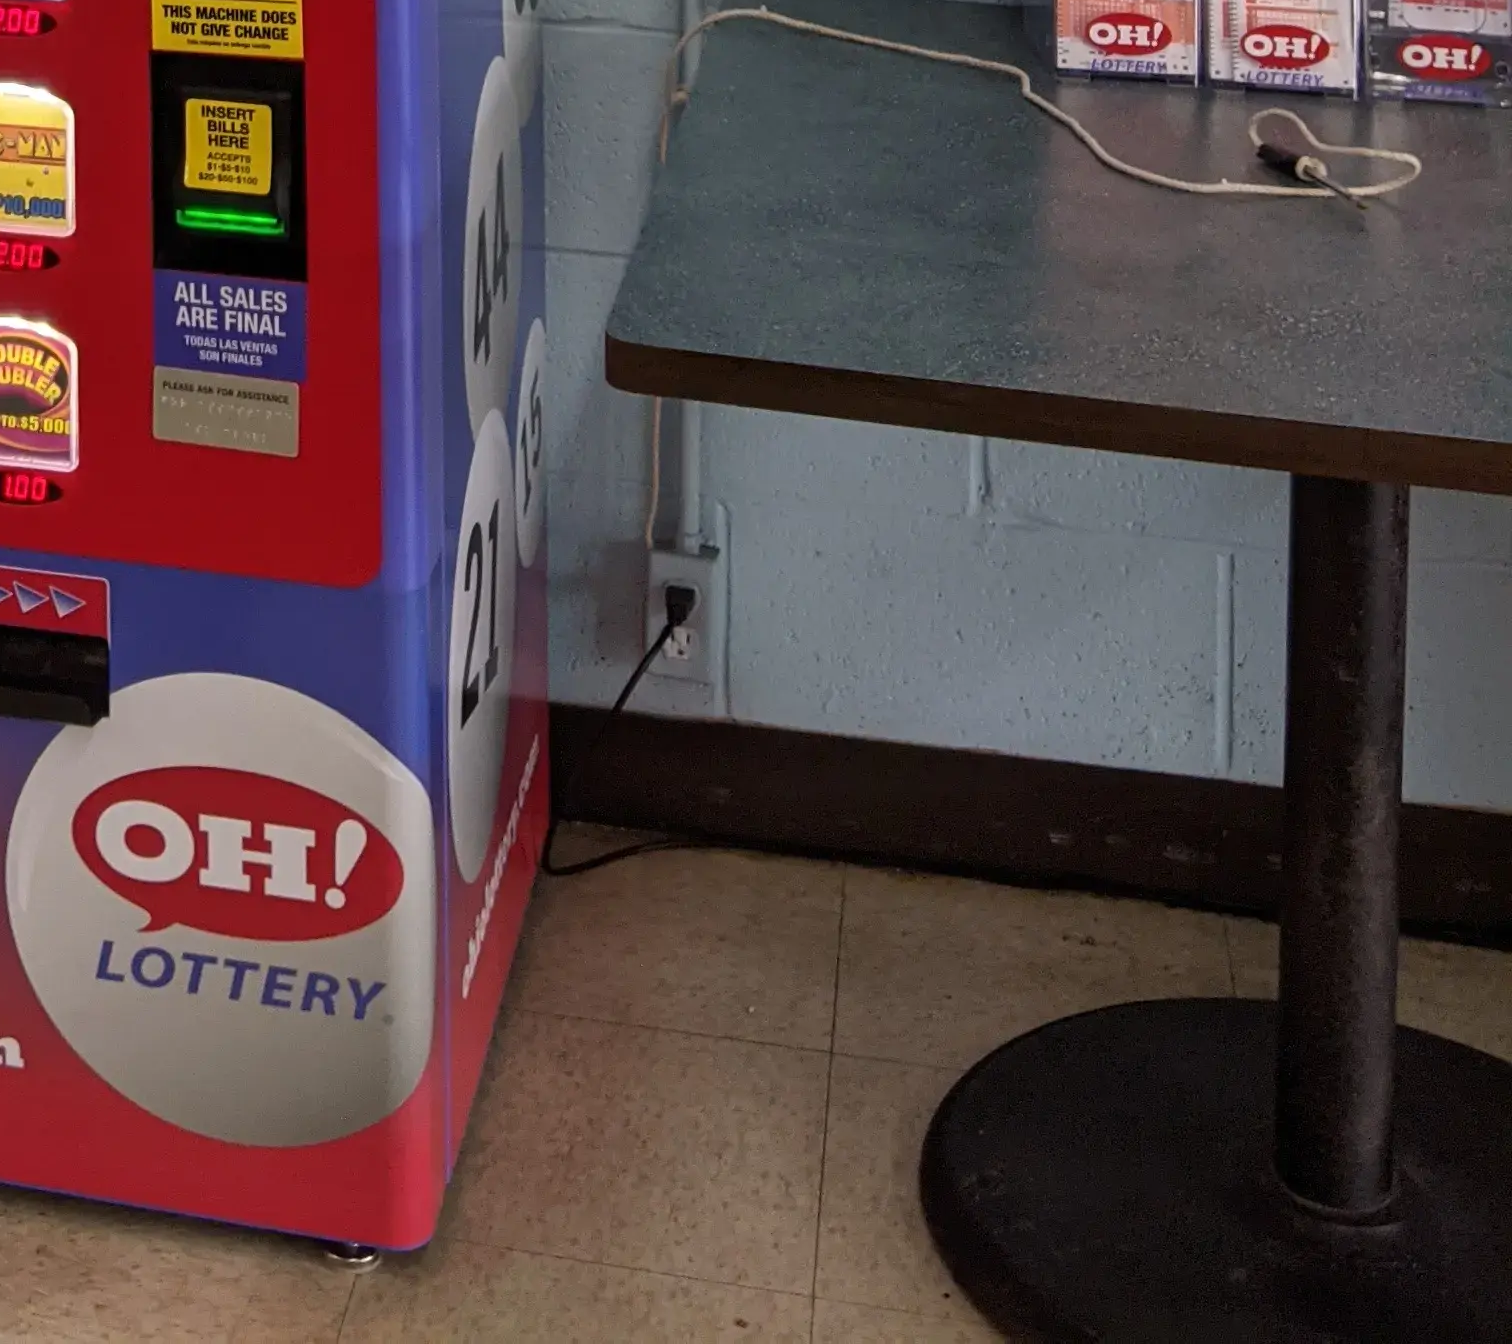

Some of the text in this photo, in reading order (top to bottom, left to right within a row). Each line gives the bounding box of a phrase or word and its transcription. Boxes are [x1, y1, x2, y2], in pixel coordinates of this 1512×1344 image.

[1089, 22, 1164, 47] OH!
[1244, 34, 1321, 60] OH!
[1246, 70, 1323, 86] LOTTERY
[201, 105, 256, 122] INSERT
[207, 120, 250, 135] BILLS
[208, 134, 249, 149] HERE
[174, 282, 287, 313] ALL SALES
[176, 306, 286, 337] ARE FINAL
[460, 498, 502, 732] 21
[93, 797, 372, 912] OH!
[94, 939, 388, 1024] LOTTERY
